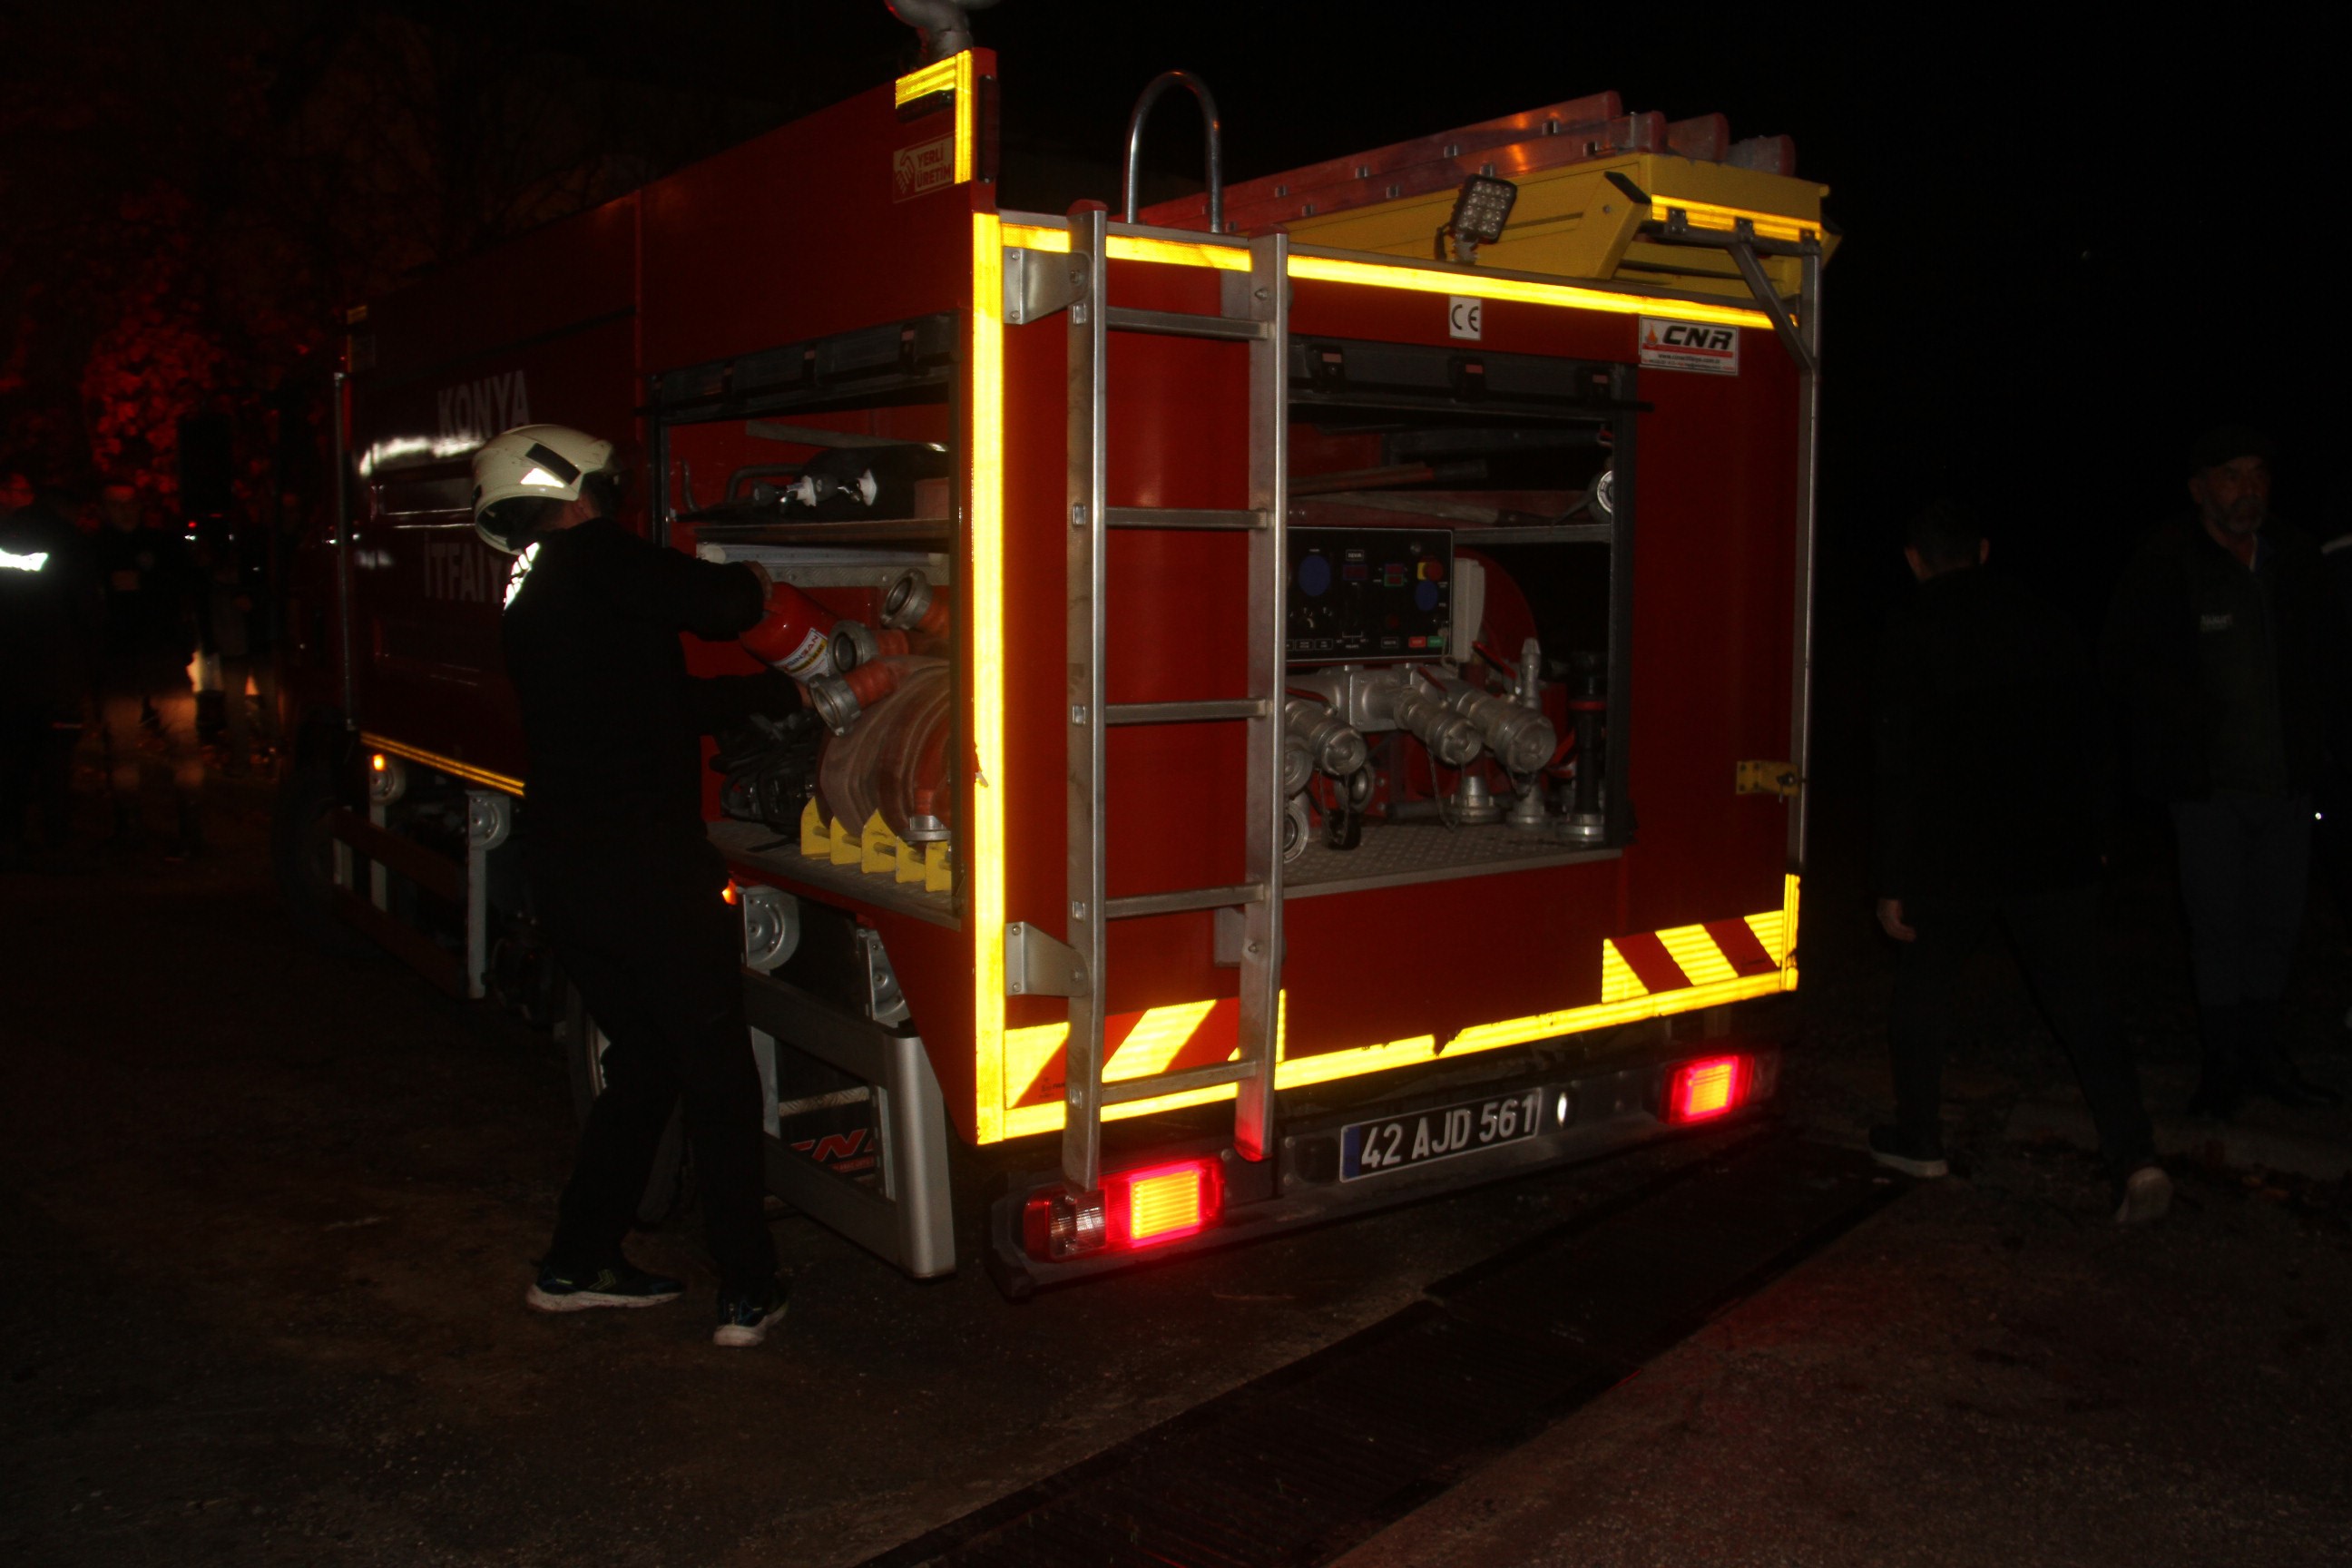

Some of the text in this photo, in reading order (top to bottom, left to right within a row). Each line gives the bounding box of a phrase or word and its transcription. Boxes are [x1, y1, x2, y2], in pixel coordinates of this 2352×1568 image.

[1452, 304, 1479, 332] CE
[1662, 325, 1733, 350] CNR
[437, 369, 531, 439] KONYA
[1361, 1093, 1534, 1168] 42 AJD 561
